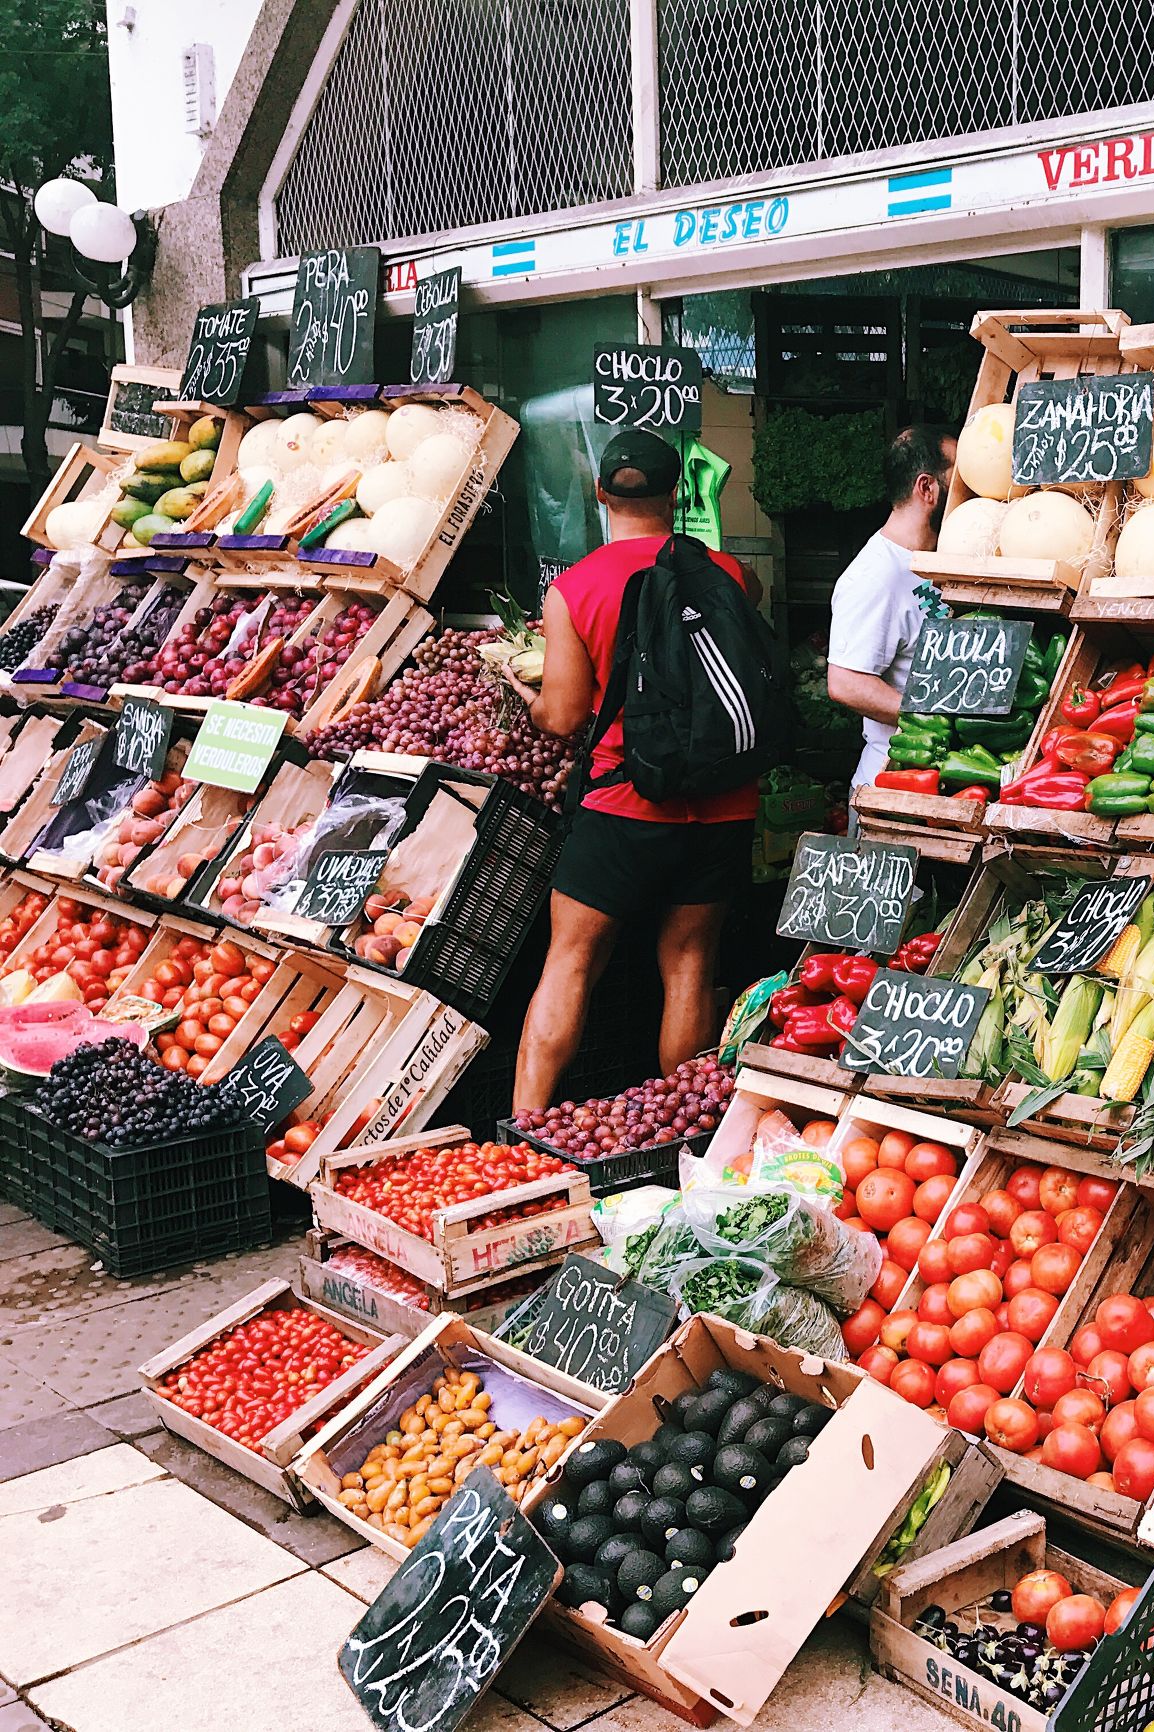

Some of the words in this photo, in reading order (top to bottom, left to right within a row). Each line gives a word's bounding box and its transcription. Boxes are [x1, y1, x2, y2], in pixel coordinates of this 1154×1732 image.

[613, 219, 649, 257] EL
[672, 196, 790, 248] DESEO
[305, 250, 352, 293] PERA
[414, 273, 459, 317] CEBOLLA
[198, 308, 251, 339] TOMATE
[595, 350, 683, 382] CHOCLO
[438, 529, 455, 547] EL
[920, 627, 1006, 670] RUCULA
[206, 714, 222, 736] SE
[223, 717, 279, 746] NECESITA
[193, 743, 268, 776] VERDULEROS
[796, 846, 914, 900] ZAPALLITO
[1067, 879, 1147, 925] CHOCLO
[866, 979, 975, 1028] CHOCLO
[253, 1047, 294, 1094] UVA
[386, 1097, 404, 1118] de
[409, 1012, 457, 1082] Calidad
[322, 1276, 379, 1320] ANGELA
[440, 1489, 526, 1624] PALTA
